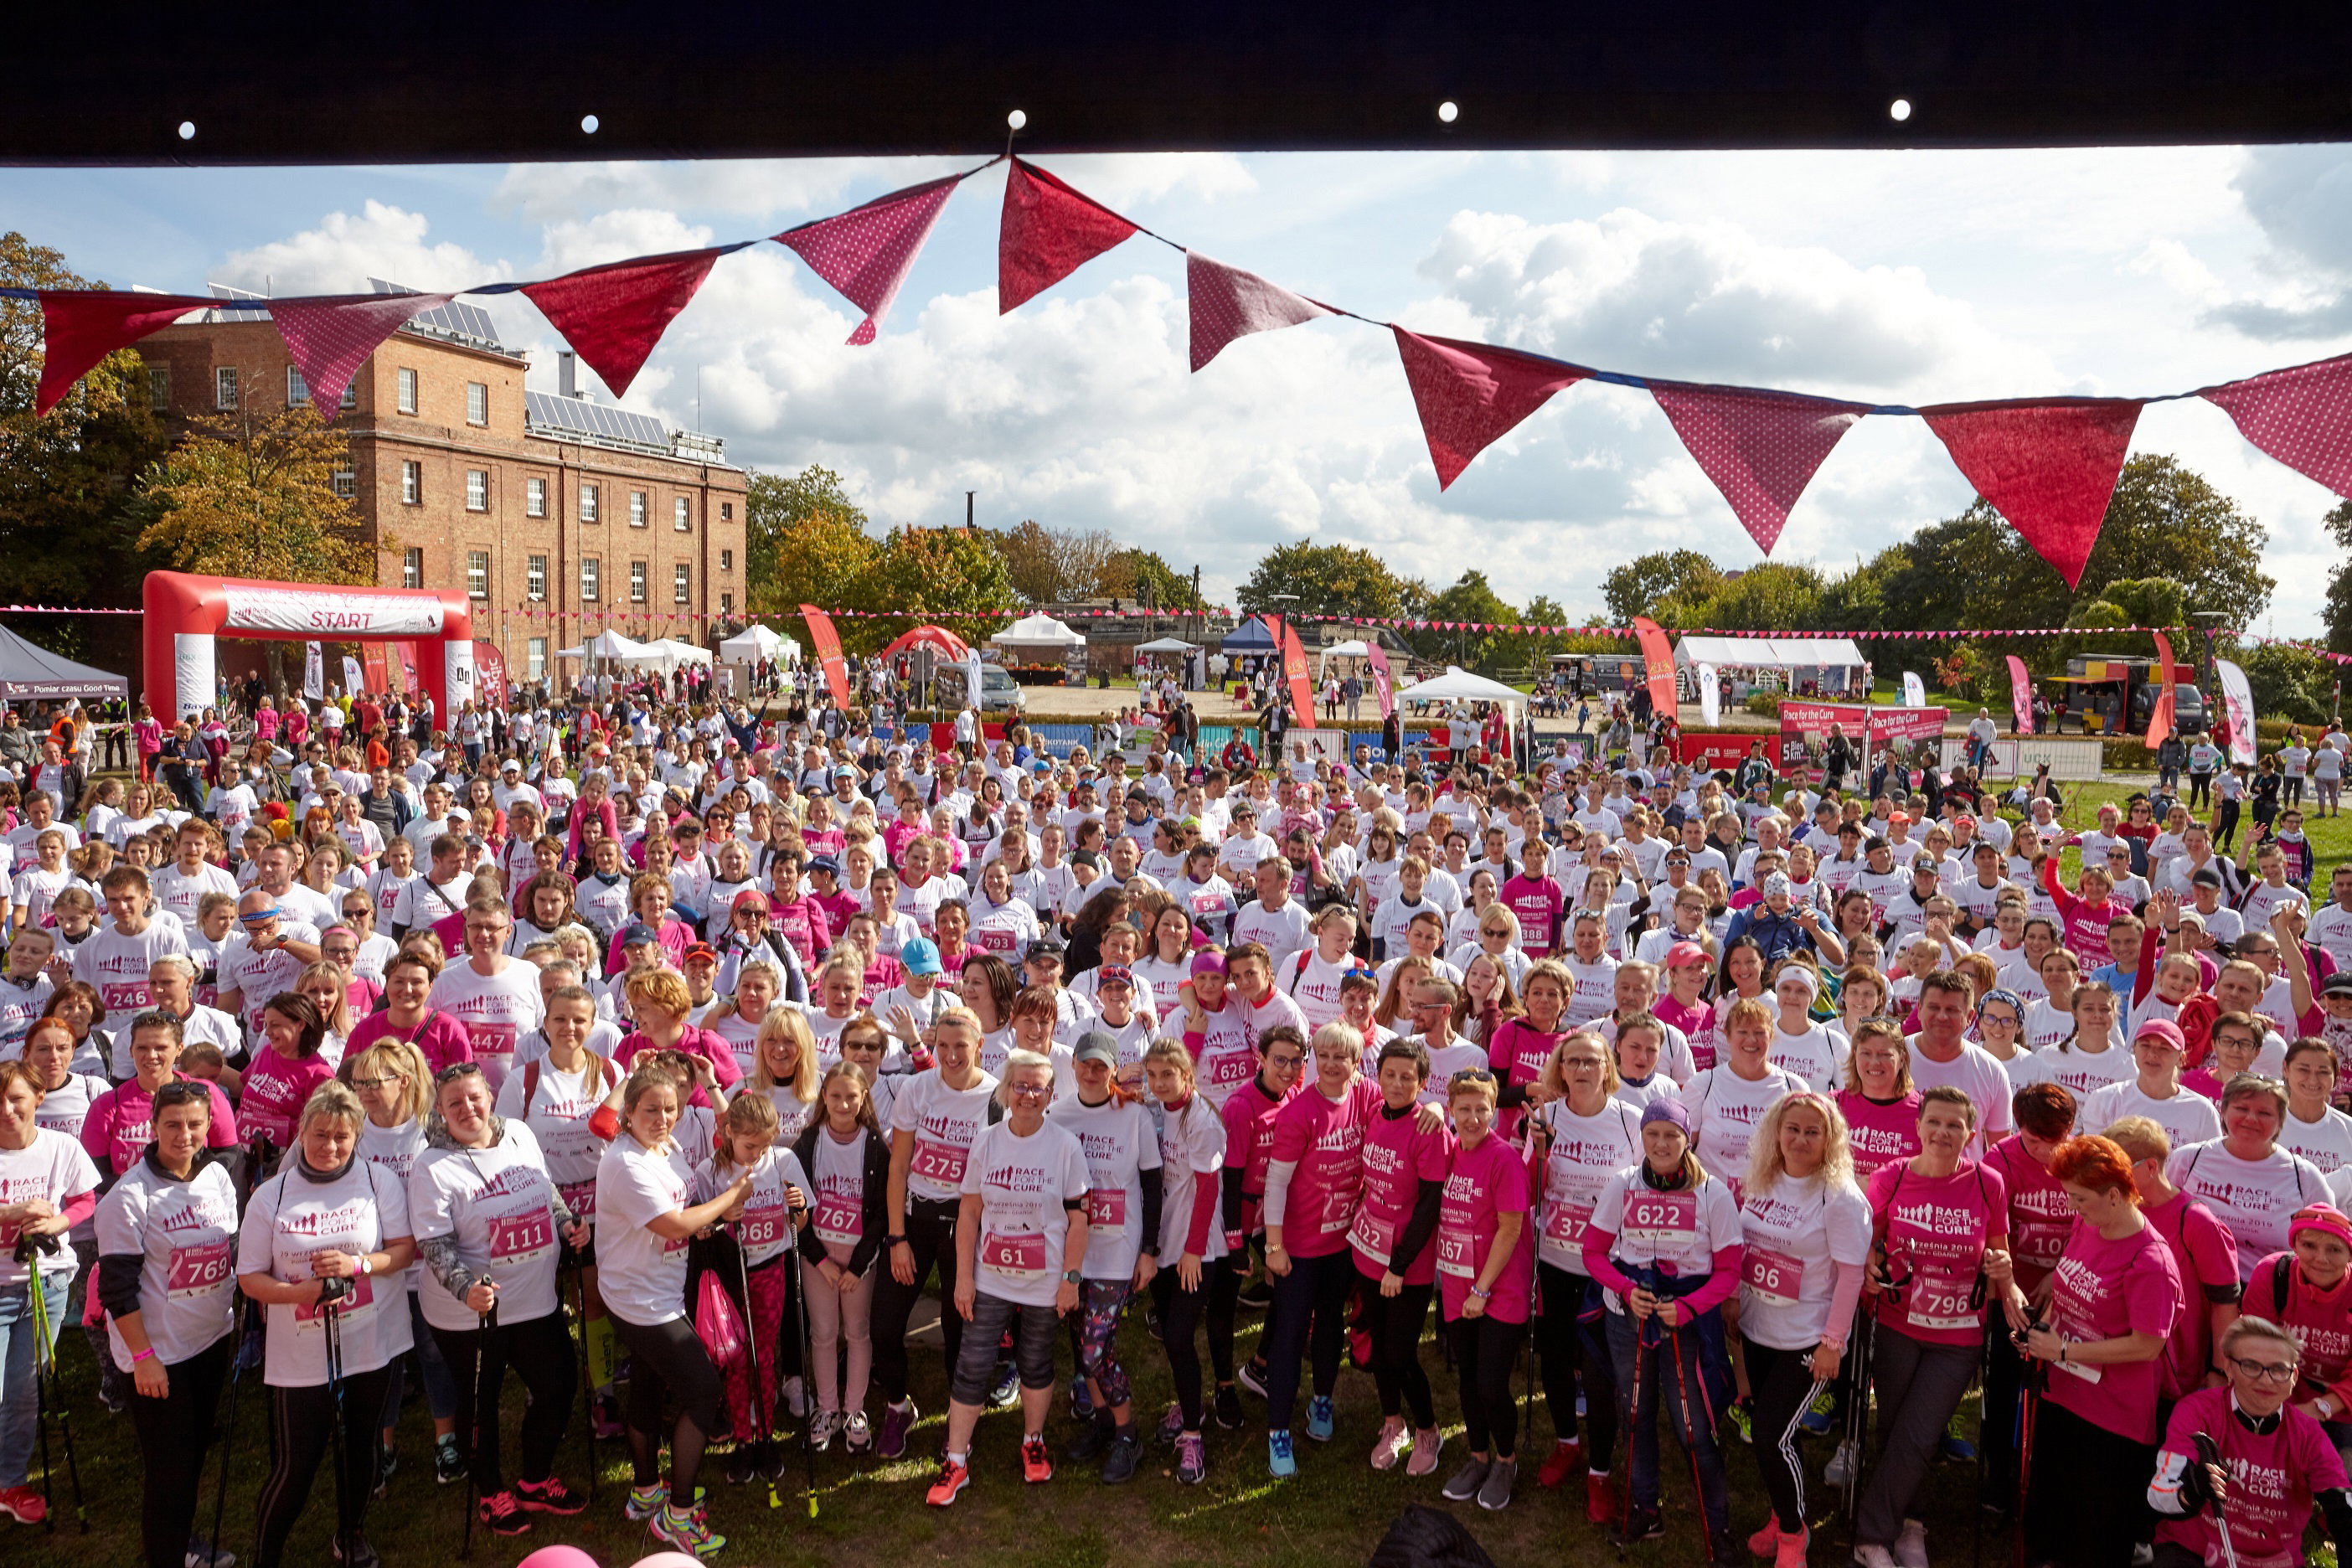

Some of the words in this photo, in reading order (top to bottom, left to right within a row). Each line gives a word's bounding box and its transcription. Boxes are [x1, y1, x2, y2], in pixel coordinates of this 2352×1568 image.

[310, 611, 374, 629] START
[34, 684, 59, 694] Pomiar
[61, 684, 82, 693] czasu
[83, 683, 102, 693] Good
[103, 683, 121, 693] Time
[1783, 709, 1798, 720] Race
[1798, 709, 1808, 720] for
[1808, 709, 1819, 720] the
[1819, 709, 1834, 720] Cure
[1873, 718, 1887, 729] Race
[1887, 715, 1896, 727] for
[1896, 714, 1906, 725] the
[1906, 712, 1919, 723] Cure
[1783, 743, 1790, 761] 5
[1790, 740, 1804, 753] Bieg
[1790, 750, 1801, 761] km
[1201, 900, 1216, 912] 56
[1522, 929, 1542, 939] 388
[985, 936, 1008, 948] 793
[123, 967, 147, 976] CURE
[113, 993, 147, 1006] 246
[486, 994, 512, 1003] RACE
[1223, 1029, 1240, 1039] RACE
[470, 1034, 506, 1050] 447
[1787, 1057, 1816, 1065] RACE
[1220, 1061, 1246, 1078] 626
[268, 1076, 290, 1090] RACE
[782, 1112, 809, 1120] RACE
[50, 1118, 82, 1128] RACE
[951, 1118, 977, 1128] RACE
[1086, 1135, 1115, 1145] RACE
[1870, 1129, 1902, 1140] RACE
[1086, 1143, 1106, 1153] FOR
[1584, 1142, 1616, 1152] RACE
[1869, 1137, 1891, 1147] FOR
[1374, 1143, 1397, 1158] RACE
[1583, 1151, 1602, 1159] FOR
[2305, 1148, 2339, 1160] RACE
[381, 1153, 415, 1164] RACE
[1583, 1158, 1615, 1167] CURE
[504, 1163, 528, 1178] RACE
[924, 1154, 962, 1179] 275
[1014, 1168, 1045, 1177] RACE
[13, 1175, 49, 1187] RACE
[1014, 1176, 1035, 1184] FOR
[1037, 1176, 1055, 1185] THE
[1453, 1174, 1474, 1187] RACE
[1560, 1172, 1594, 1182] września
[2236, 1186, 2272, 1197] RACE
[2235, 1194, 2261, 1204] FOR
[2262, 1195, 2286, 1206] THE
[321, 1206, 358, 1220] RACE
[1774, 1201, 1801, 1213] RACE
[1935, 1205, 1970, 1217] RACE
[820, 1206, 857, 1230] 767
[1637, 1204, 1680, 1225] 622
[1935, 1215, 1961, 1227] FOR
[1961, 1215, 1982, 1227] THE
[2248, 1218, 2273, 1228] 2019
[321, 1224, 358, 1235] CURE
[740, 1220, 774, 1241] 968
[1356, 1219, 1382, 1249] 122
[506, 1225, 544, 1251] 111
[1440, 1241, 1463, 1261] 267
[1951, 1243, 1974, 1253] 2019
[1000, 1248, 1025, 1266] 61
[188, 1256, 228, 1284] 769
[1752, 1263, 1780, 1289] 96
[1927, 1292, 1968, 1315] 796
[2312, 1328, 2350, 1342] RACE
[2310, 1342, 2349, 1356] CURE
[2250, 1464, 2286, 1482] RACE
